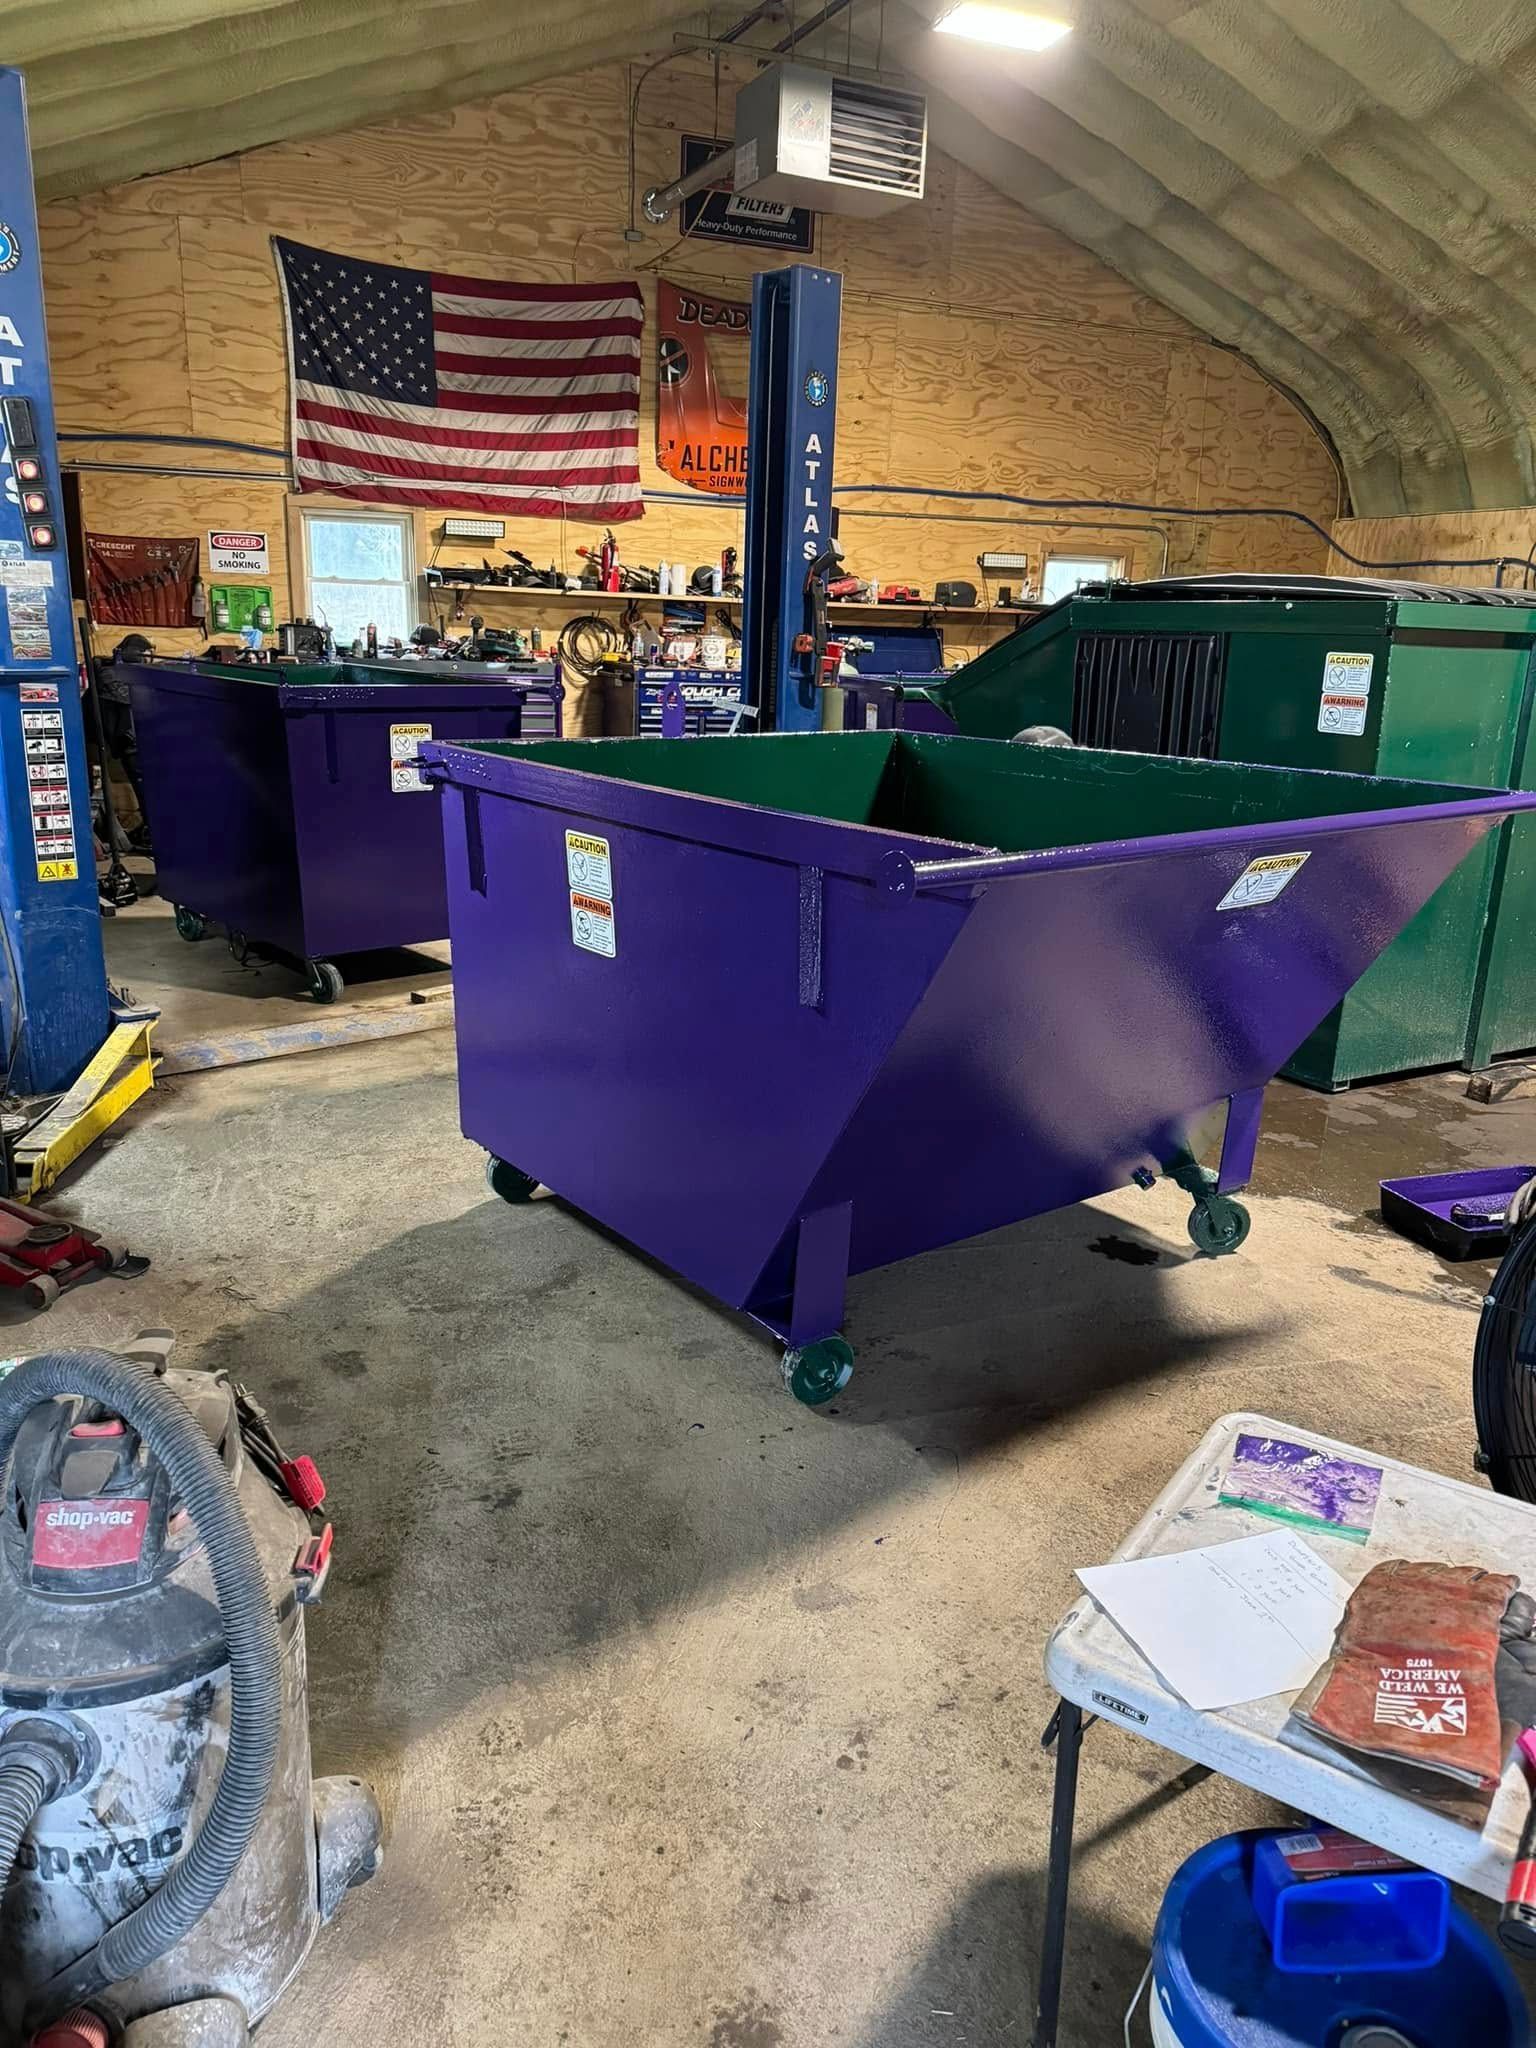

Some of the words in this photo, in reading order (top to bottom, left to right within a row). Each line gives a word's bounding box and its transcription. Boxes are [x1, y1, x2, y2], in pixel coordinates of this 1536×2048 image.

[736, 197, 785, 216] FILTERS
[745, 225, 798, 241] Performance
[676, 297, 752, 333] DEAD
[680, 444, 749, 473] ALCHE
[709, 475, 748, 488] SIGNW
[803, 433, 823, 561] ATLAS
[95, 541, 136, 551] CRESCENT
[218, 537, 257, 547] DANGER
[231, 551, 246, 560] NO
[218, 560, 261, 570] SMOKING
[1336, 656, 1370, 666] CAUTION
[1330, 696, 1365, 707] WARNING
[399, 727, 429, 735] CAUTION
[574, 837, 607, 856] CAUTION
[1257, 856, 1304, 872] CAUTION
[580, 897, 612, 916] WARNING
[1406, 1658, 1433, 1668] 1075
[1379, 1667, 1462, 1681] AMERICA
[1379, 1680, 1430, 1694] WELD
[1434, 1682, 1465, 1695] WE
[1099, 1695, 1140, 1720] LIFETIME
